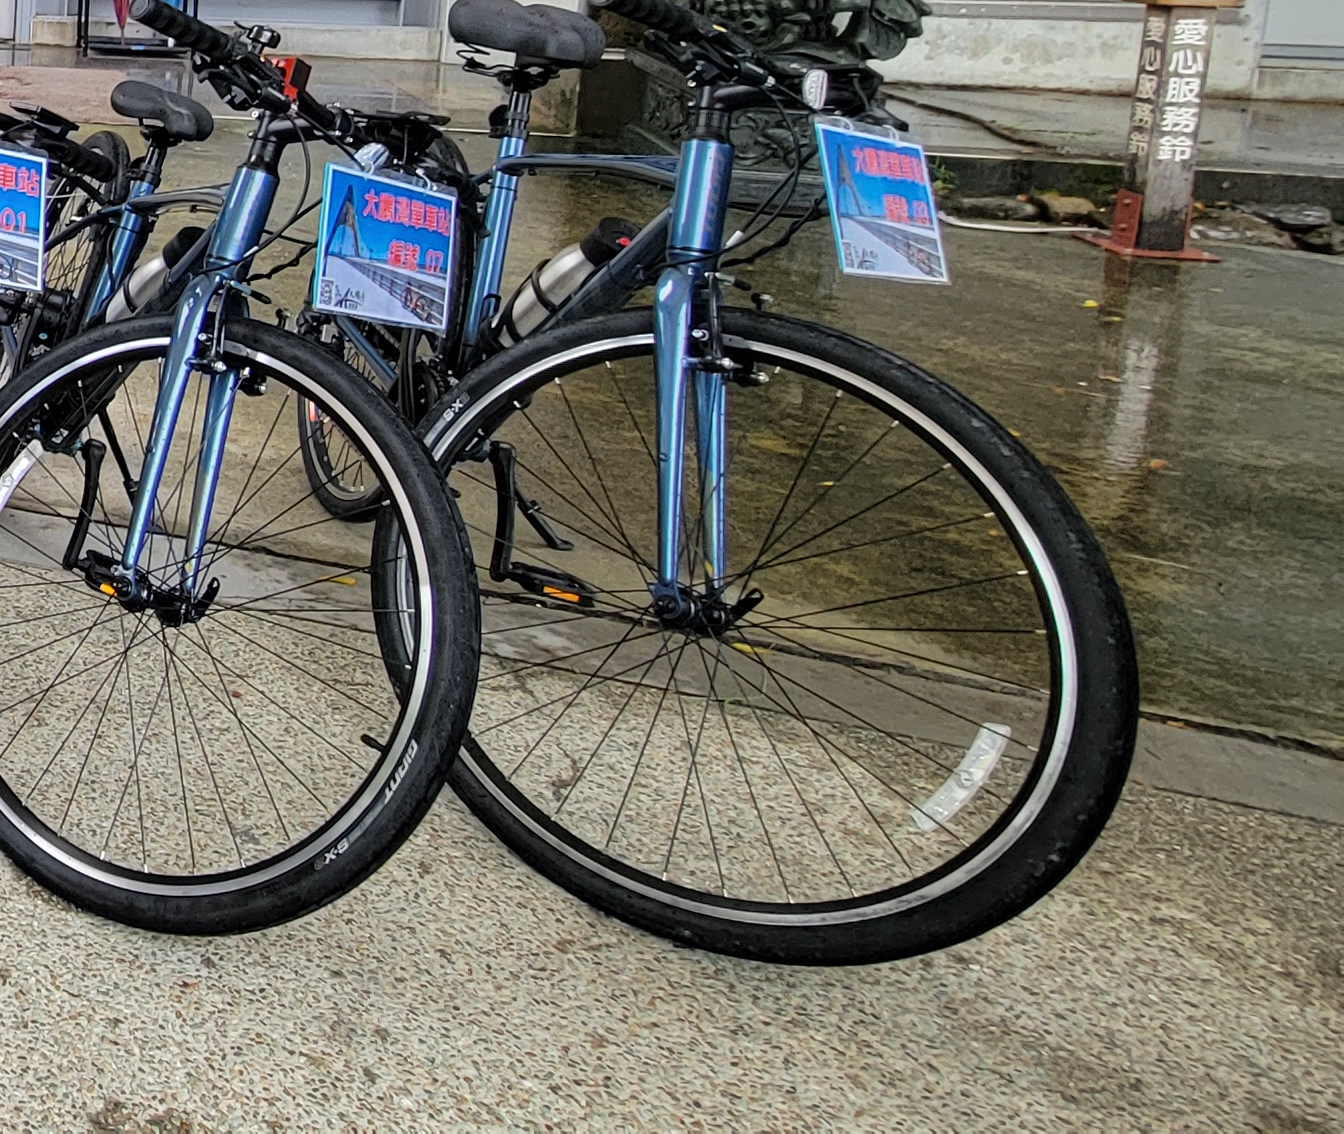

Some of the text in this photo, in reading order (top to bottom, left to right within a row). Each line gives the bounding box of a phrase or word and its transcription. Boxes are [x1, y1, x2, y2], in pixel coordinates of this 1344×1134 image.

[1156, 18, 1209, 162] 愛心服務鈴
[0, 208, 27, 233] 01
[385, 738, 417, 805] GIANT
